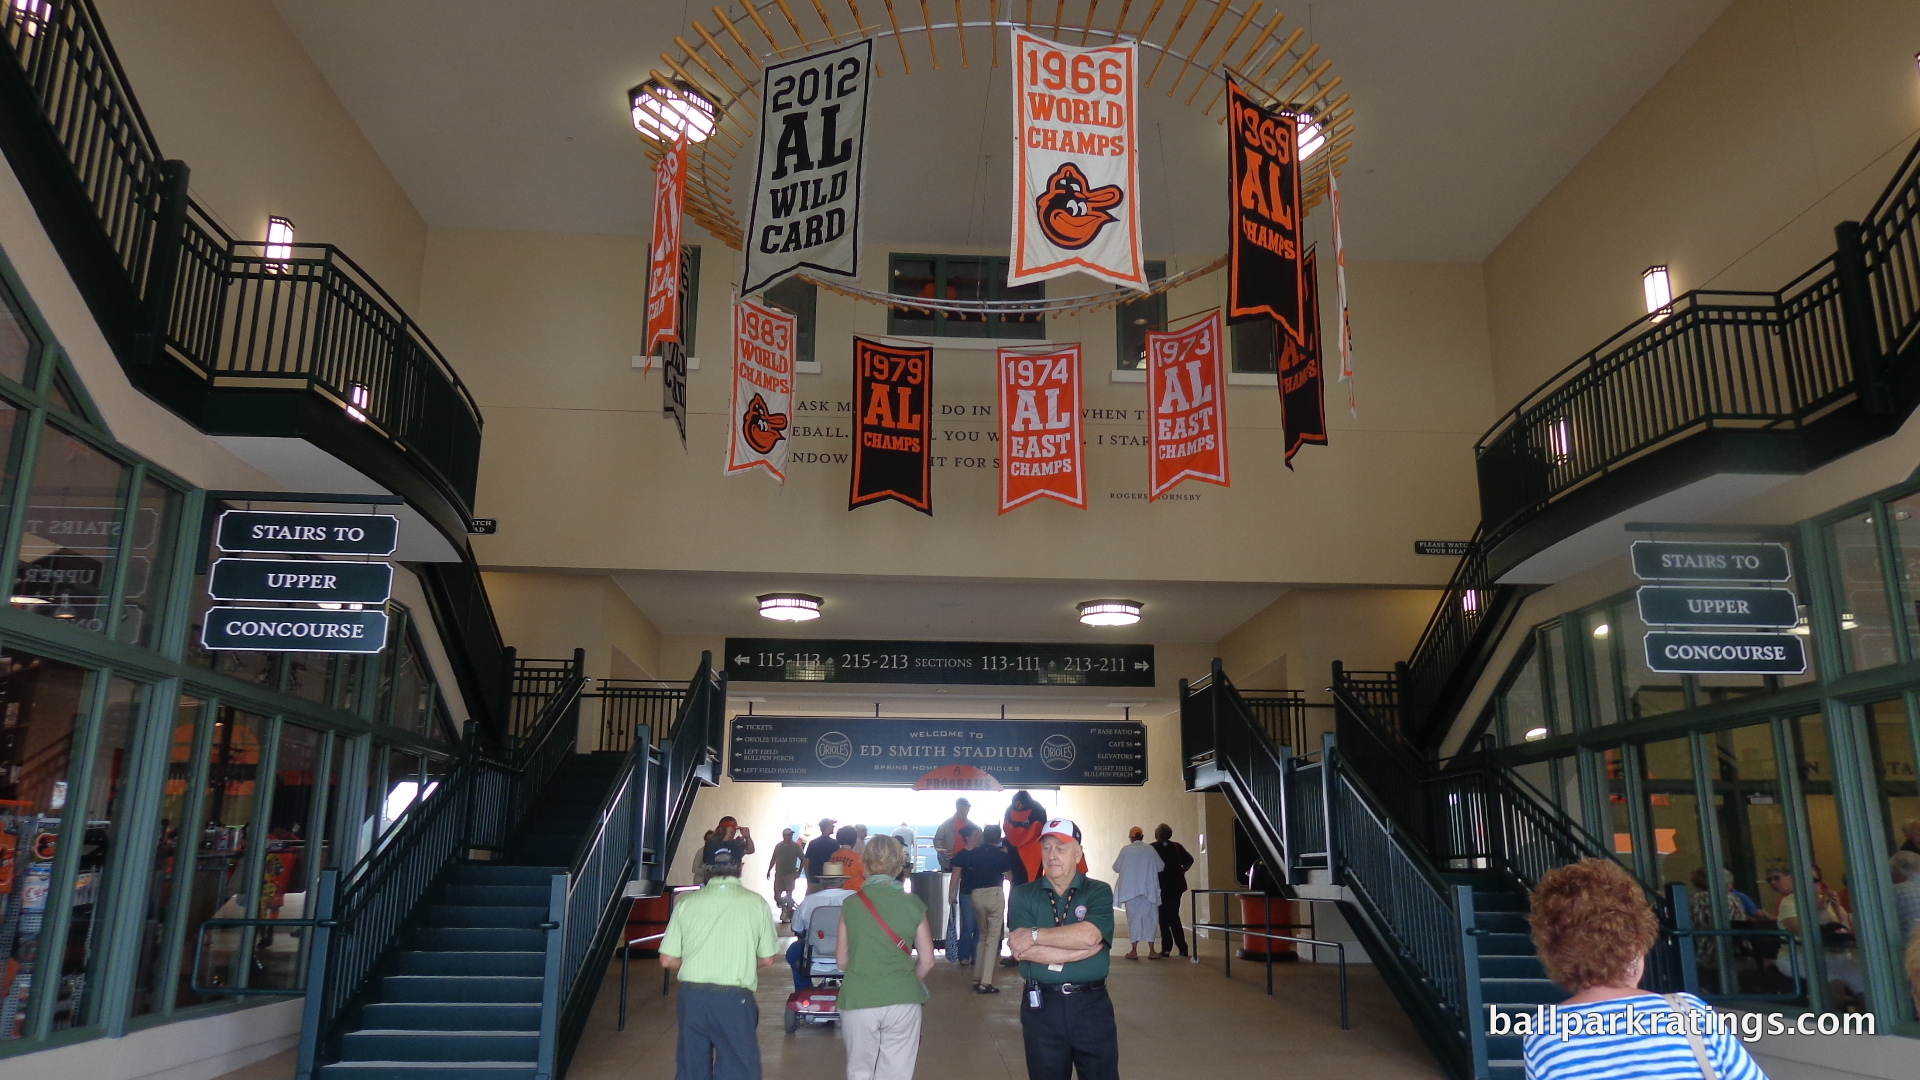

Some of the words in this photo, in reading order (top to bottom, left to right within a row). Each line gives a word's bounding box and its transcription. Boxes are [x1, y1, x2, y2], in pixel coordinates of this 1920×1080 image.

[772, 56, 860, 113] 2012
[1027, 50, 1122, 95] 1966
[1027, 92, 1124, 128] WORLD
[772, 104, 852, 180] AL
[1027, 126, 1124, 156] CHAMPS
[769, 169, 848, 219] WILD
[1241, 147, 1292, 230] AL
[760, 207, 845, 254] CARD
[741, 308, 788, 351] 1983
[740, 337, 788, 374] WORLD
[1154, 329, 1211, 367] 1973
[739, 362, 790, 394] CHAMPS
[863, 351, 923, 385] 1979
[1007, 358, 1069, 387] 1974
[1158, 360, 1212, 414] AL
[797, 402, 830, 412] ASK
[837, 402, 851, 412] M
[942, 405, 966, 416] DO
[972, 405, 992, 416] IN
[863, 382, 921, 431] AL
[1011, 388, 1071, 432] AL
[792, 427, 849, 438] EBALL.
[944, 431, 979, 442] YOU
[1110, 435, 1149, 446] STAR
[1158, 406, 1213, 441] EAST
[863, 431, 921, 453] CHAMPS
[1011, 432, 1071, 459] EAST
[1159, 434, 1215, 460] CHAMPS
[788, 453, 849, 464] NDOW
[954, 457, 986, 468] FOR
[1010, 458, 1072, 477] CHAMPS
[1110, 492, 1148, 500] ROGERS
[1157, 493, 1202, 501] ORNSBY
[252, 524, 327, 541] STAIRS
[333, 527, 365, 542] TO
[1662, 554, 1726, 568] STAIRS
[1731, 555, 1760, 569] TO
[267, 573, 337, 589] UPPER
[1687, 599, 1750, 614] UPPER
[226, 621, 364, 639] CONCOURSE
[758, 652, 820, 668] 115-113
[842, 653, 909, 669] 215-213
[915, 658, 973, 668] SECTIONS
[982, 655, 1040, 671] 113-111
[1064, 656, 1126, 672] 213-211
[1665, 645, 1786, 660] CONCOURSE
[819, 743, 849, 756] ORIOLES
[860, 745, 882, 756] ED
[889, 745, 946, 757] SMITH
[953, 746, 1033, 758] STADIUM
[1044, 745, 1072, 759] ORIOLES
[926, 778, 991, 790] PROGRAMS
